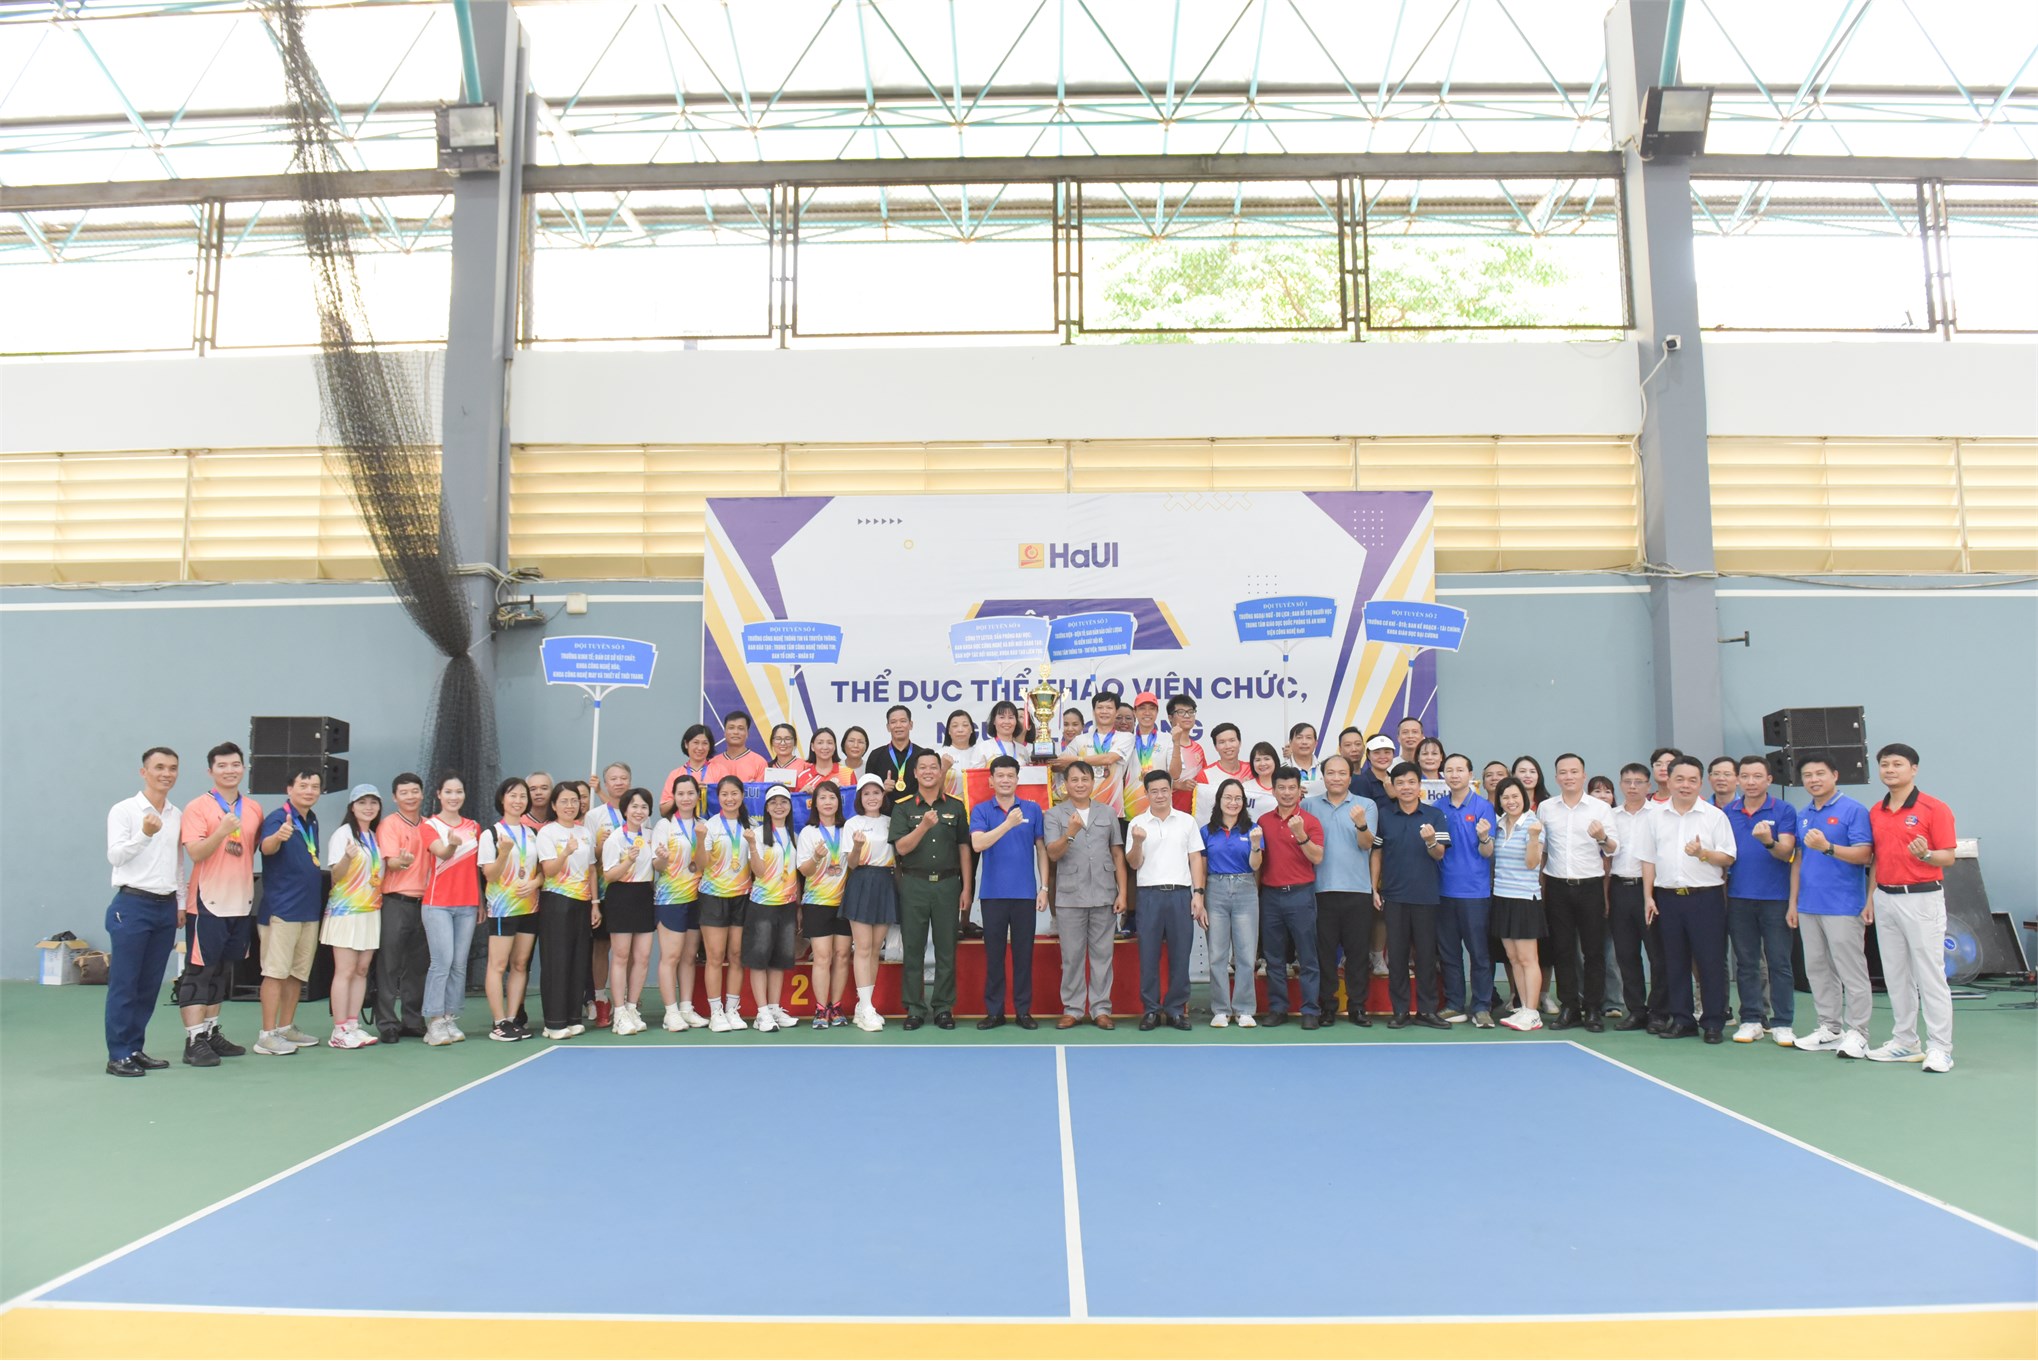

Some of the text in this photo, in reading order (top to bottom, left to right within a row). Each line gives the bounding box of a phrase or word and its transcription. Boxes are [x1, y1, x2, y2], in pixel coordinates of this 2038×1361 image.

[1050, 542, 1118, 568] HaUI
[831, 669, 891, 702] THỂ
[899, 680, 962, 709] DỤC
[971, 668, 1031, 701] THỂ
[1132, 671, 1202, 700] VIÊN
[1211, 670, 1307, 703] CHỨC,
[791, 974, 809, 1005] 2
